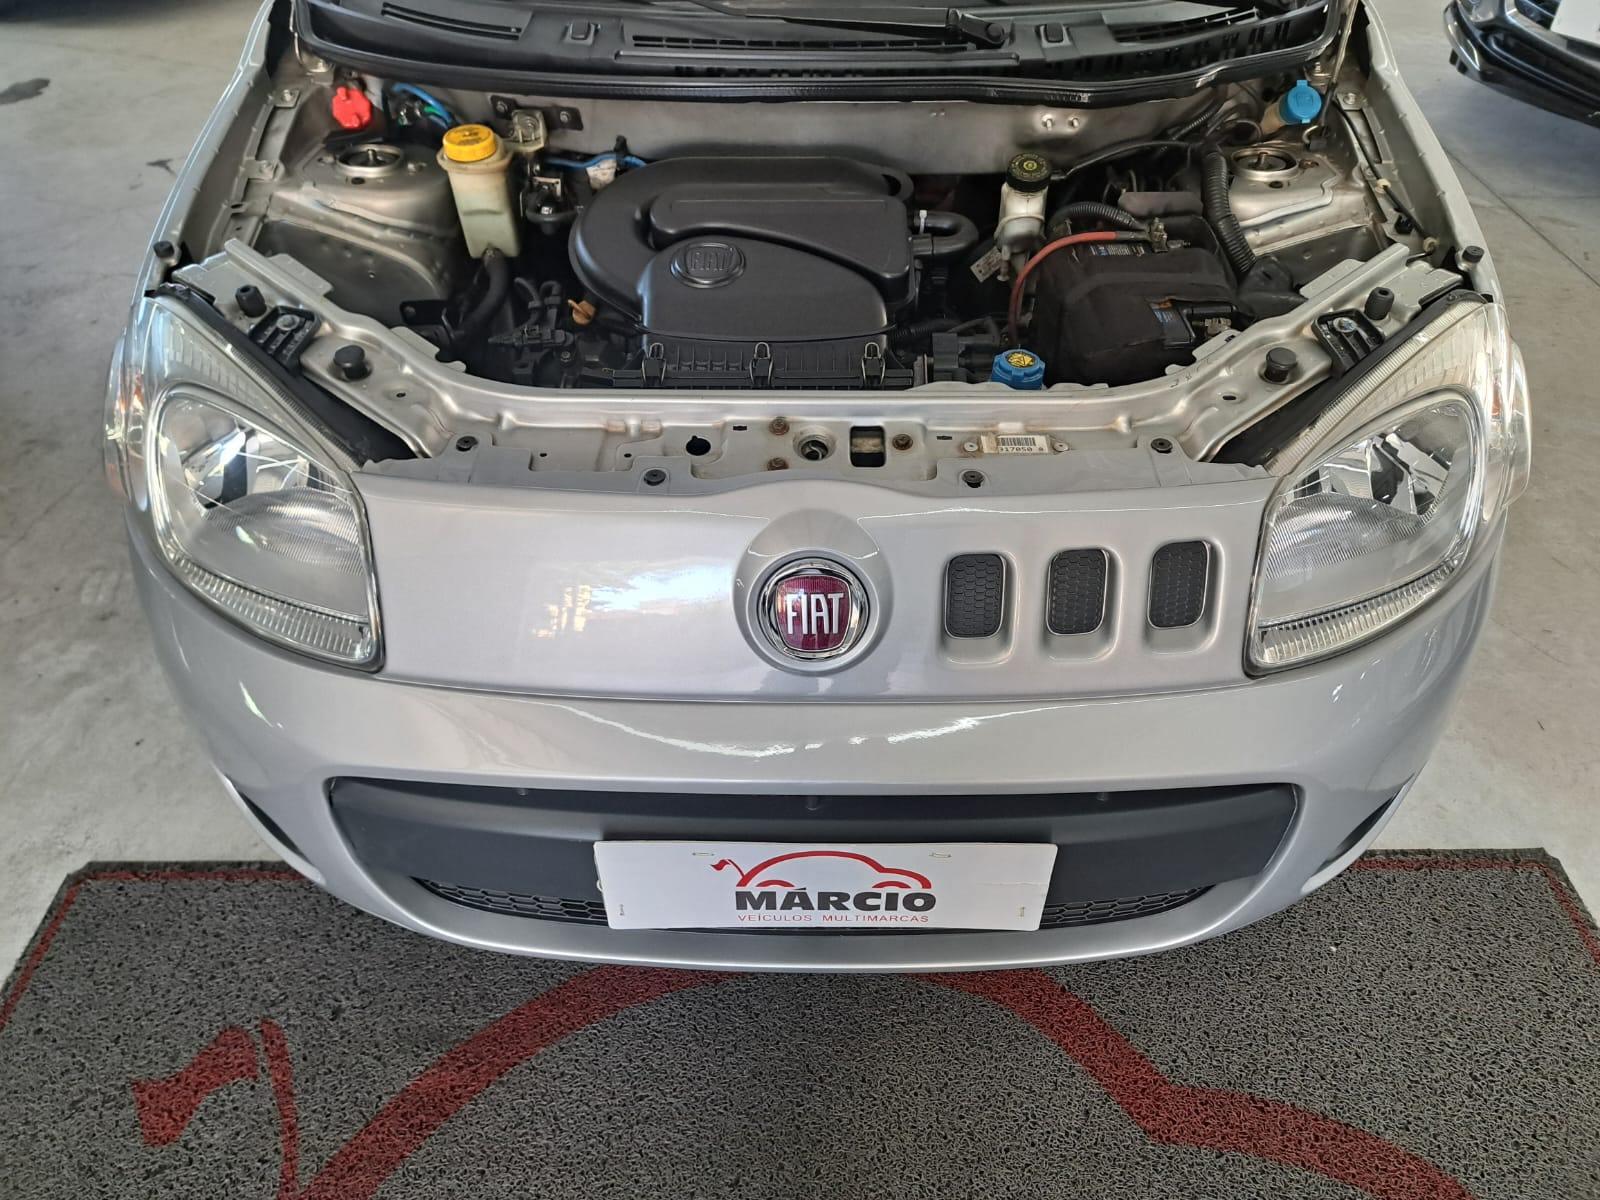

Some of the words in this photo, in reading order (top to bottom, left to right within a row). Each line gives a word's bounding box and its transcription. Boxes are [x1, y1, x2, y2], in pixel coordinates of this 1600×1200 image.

[690, 249, 733, 271] FIAT
[785, 592, 844, 635] FIAT
[735, 887, 936, 912] MÁRCIO
[737, 913, 813, 923] VEÍCULOS
[822, 913, 929, 923] MULTIMARCAS
